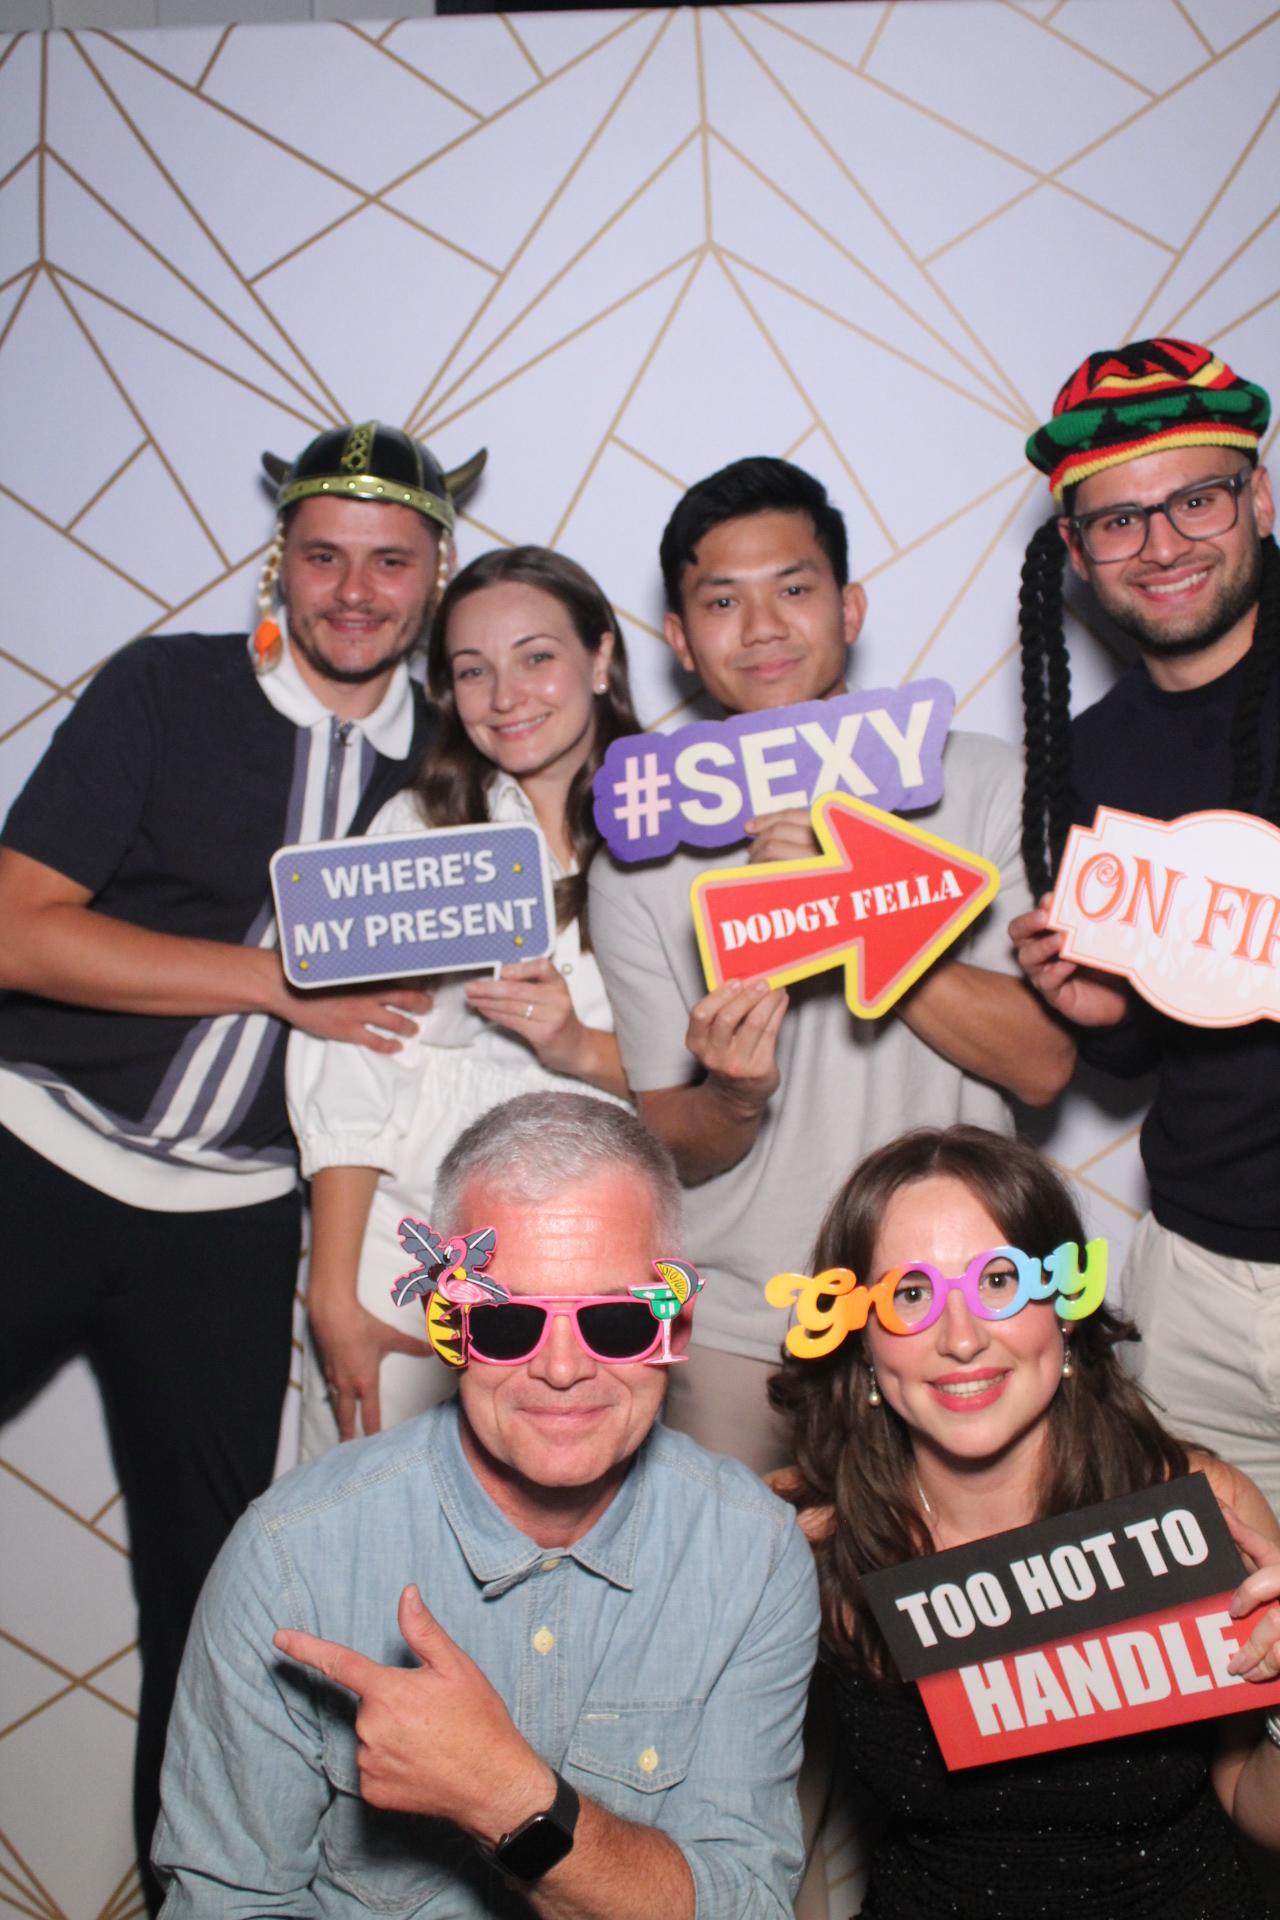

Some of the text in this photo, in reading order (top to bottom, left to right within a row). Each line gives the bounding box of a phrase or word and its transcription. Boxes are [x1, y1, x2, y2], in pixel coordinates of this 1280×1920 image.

[613, 700, 934, 840] #SEXY
[320, 850, 497, 899] WHERE'S
[719, 869, 964, 951] DODGY FELLA
[1074, 852, 1187, 938] ON
[293, 897, 538, 956] MY PRESENT
[895, 1508, 1209, 1648] TOO HOT TO
[958, 1610, 1247, 1737] HANDLE
